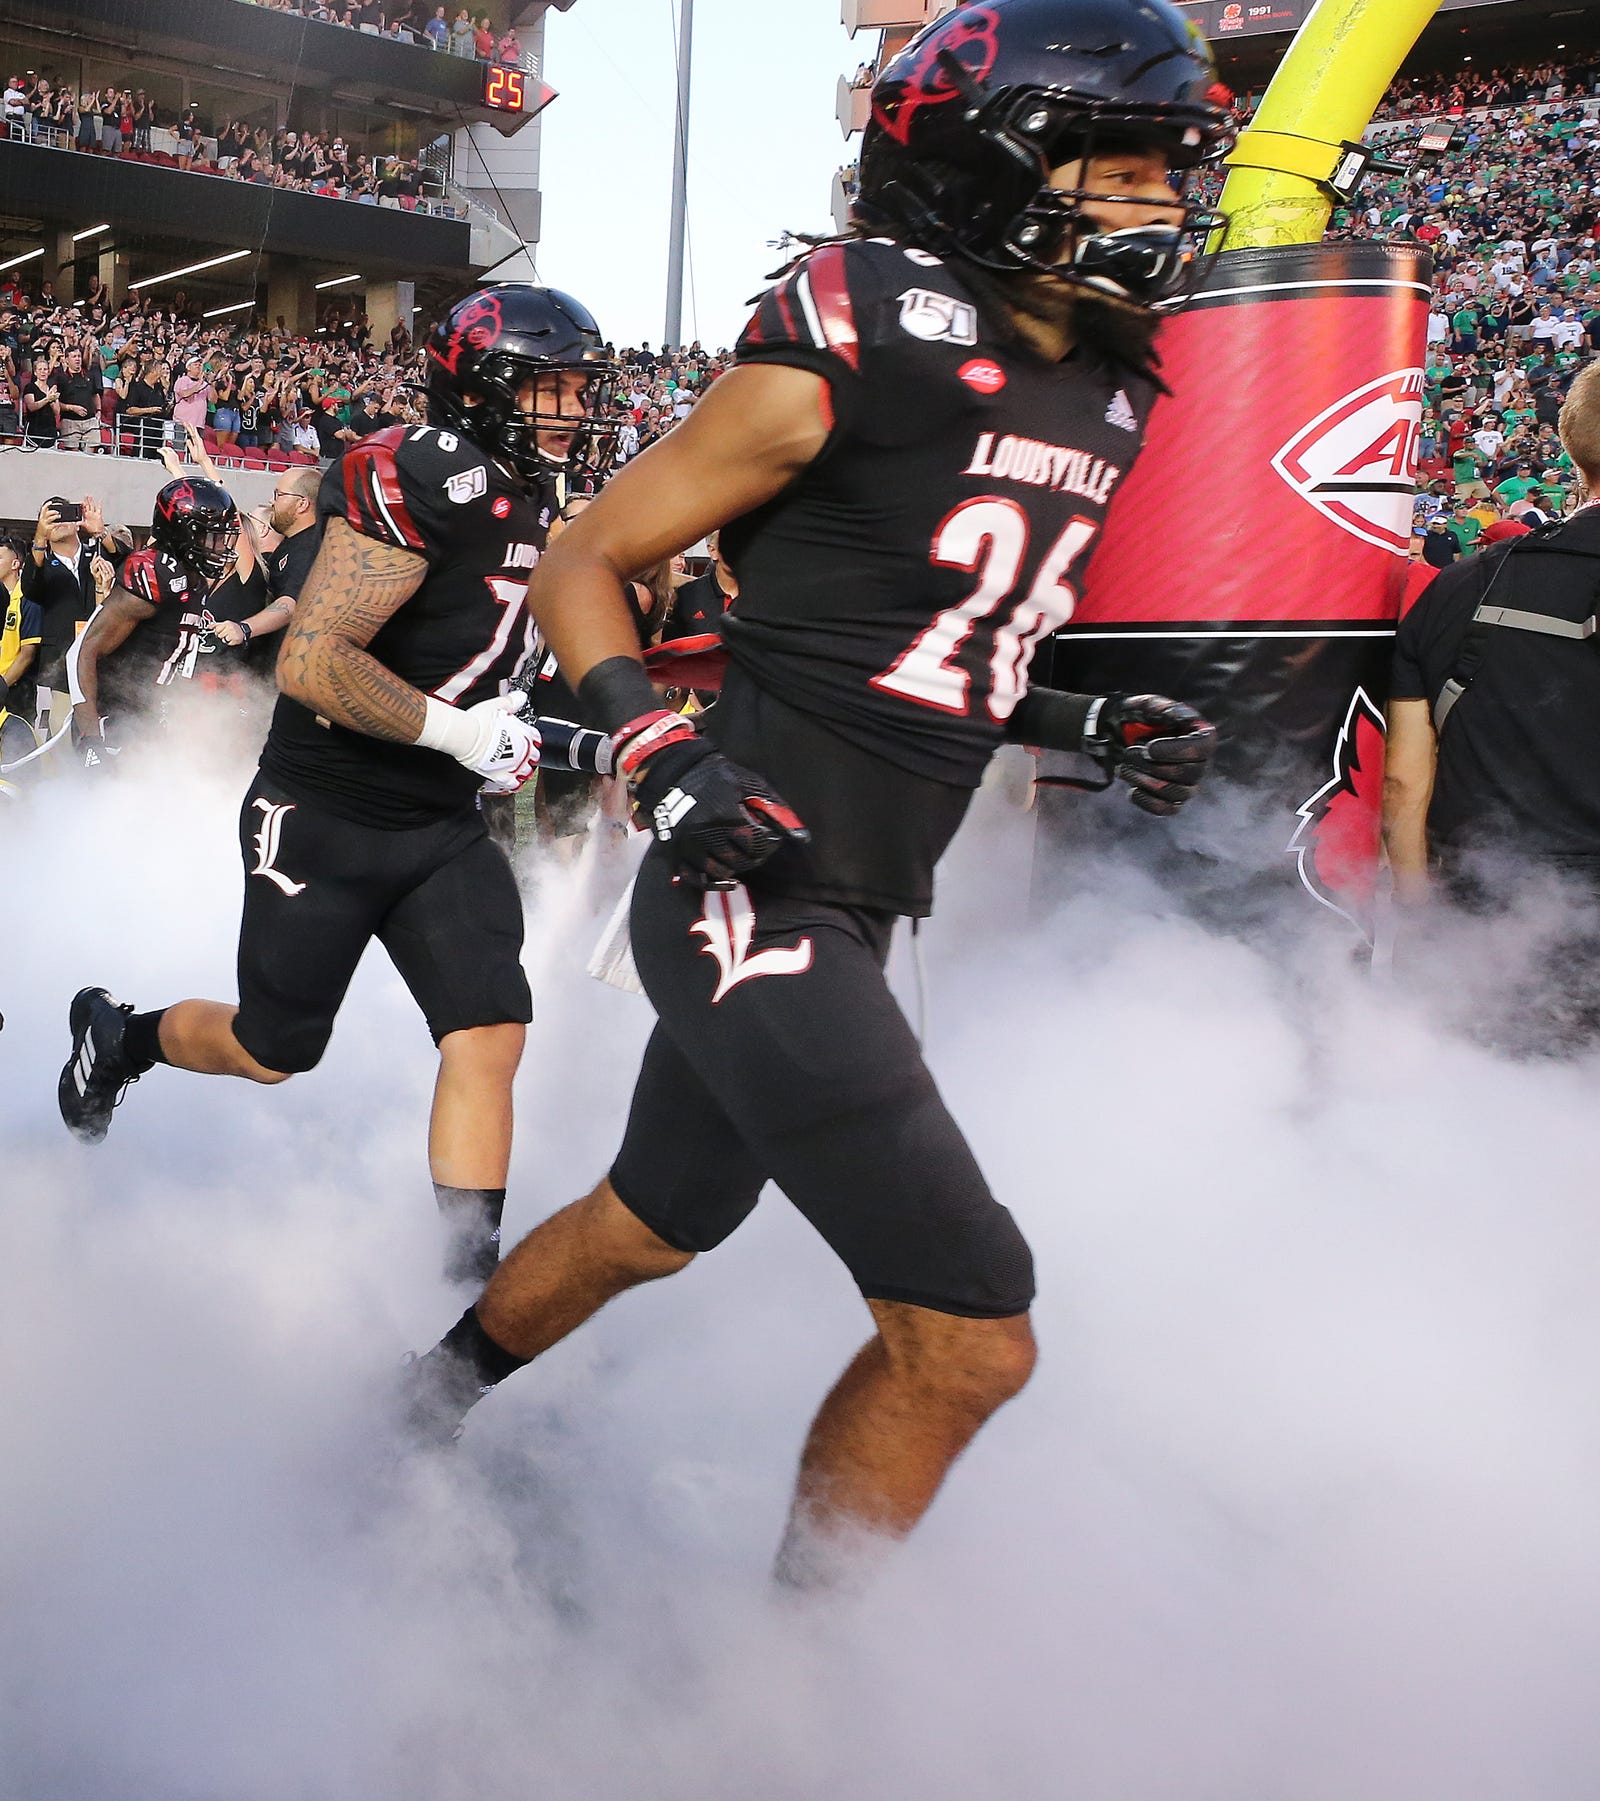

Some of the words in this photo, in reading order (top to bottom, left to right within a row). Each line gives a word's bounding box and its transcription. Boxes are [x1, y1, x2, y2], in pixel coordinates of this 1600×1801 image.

[1248, 6, 1271, 16] 1991
[487, 66, 523, 109] 25
[896, 287, 978, 347] 150
[958, 431, 1121, 505] LOUISVILLE
[866, 494, 1099, 725] 26
[489, 729, 507, 763] adidas
[250, 796, 307, 897] L
[686, 880, 816, 1007] L
